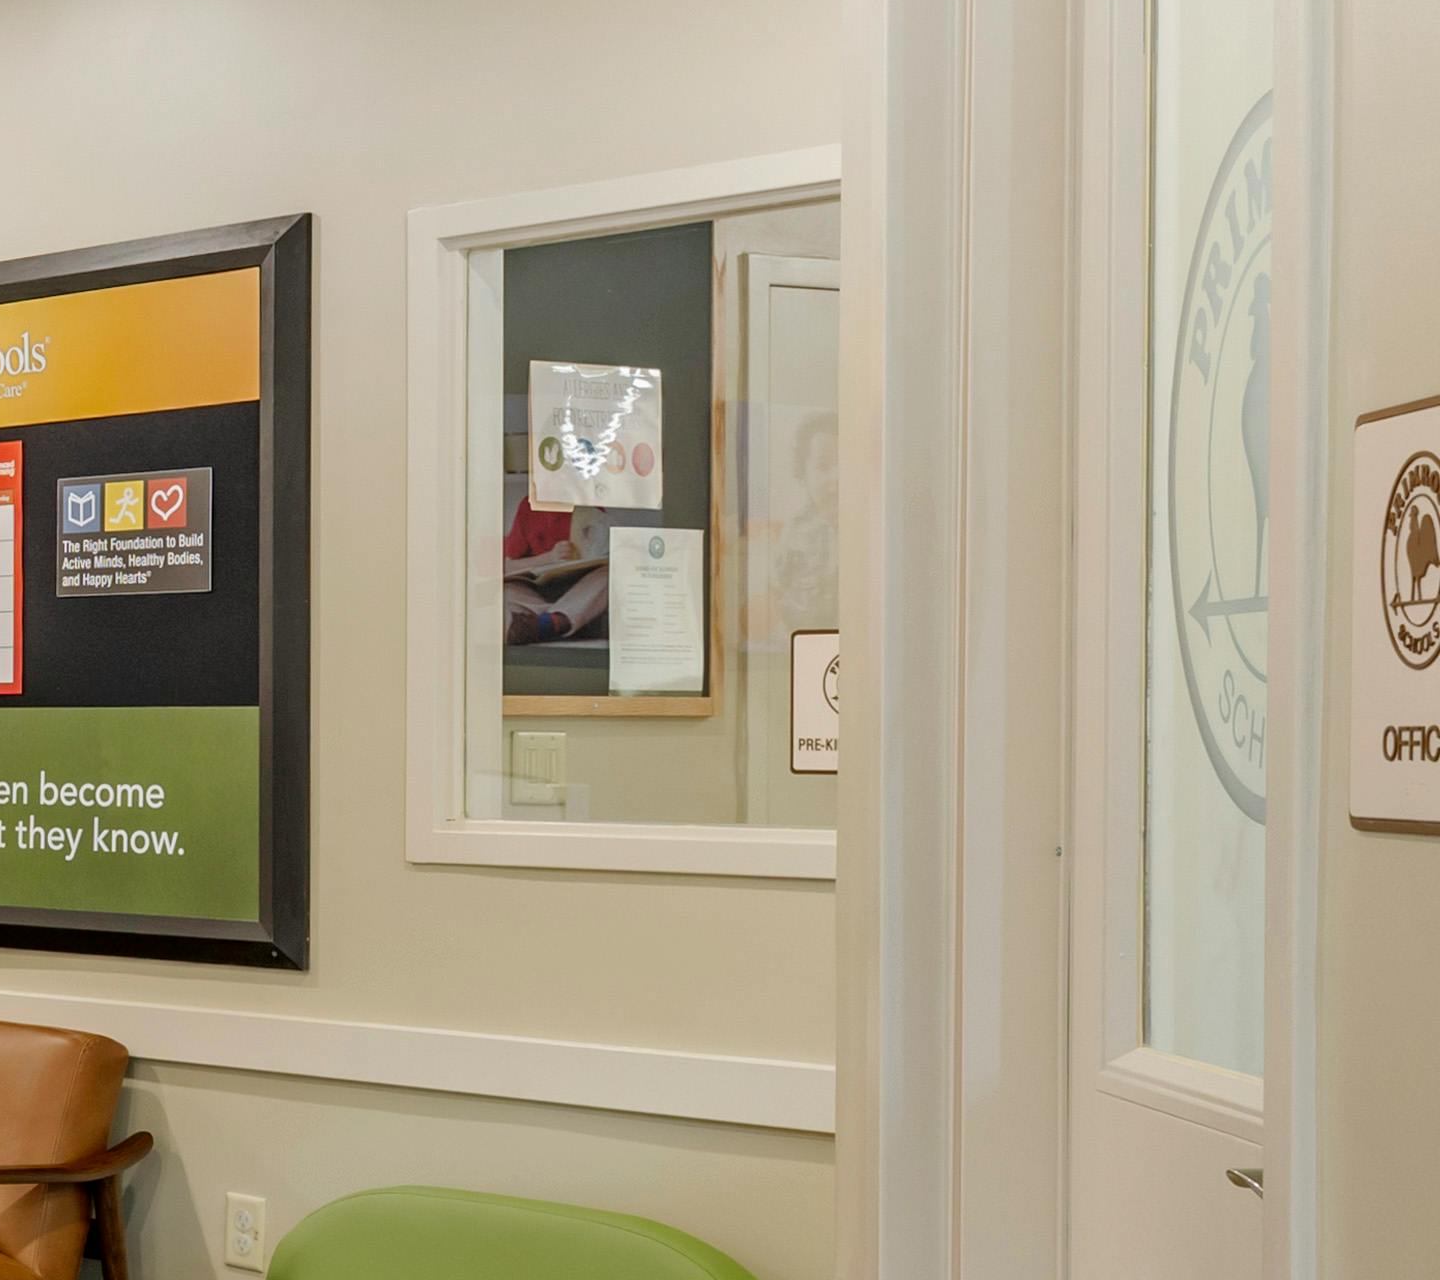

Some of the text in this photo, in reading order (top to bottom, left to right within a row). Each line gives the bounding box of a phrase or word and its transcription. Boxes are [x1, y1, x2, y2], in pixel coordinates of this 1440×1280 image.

[62, 533, 204, 554] The Right Foundation to Build
[62, 551, 204, 570] Active Minds, Healthy Bodies,
[62, 574, 80, 587] and
[83, 573, 113, 587] Happy
[39, 771, 165, 809] become
[15, 814, 84, 862] they
[92, 817, 186, 857] know.
